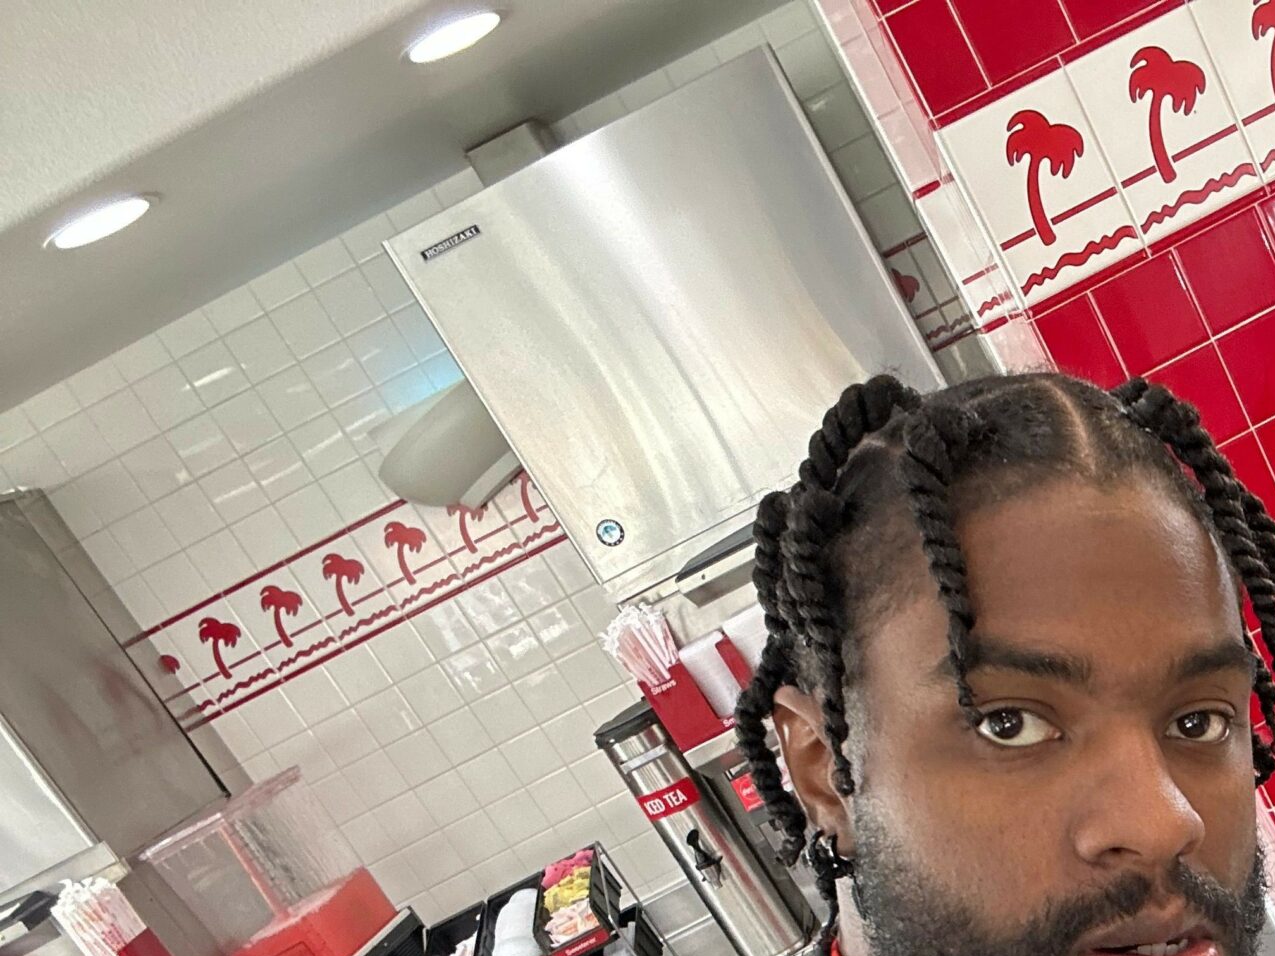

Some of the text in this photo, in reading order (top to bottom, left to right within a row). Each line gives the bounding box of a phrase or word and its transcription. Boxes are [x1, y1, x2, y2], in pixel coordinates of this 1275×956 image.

[424, 227, 477, 258] HOSHIZAKI
[651, 680, 677, 696] Straws
[663, 788, 688, 810] TEA
